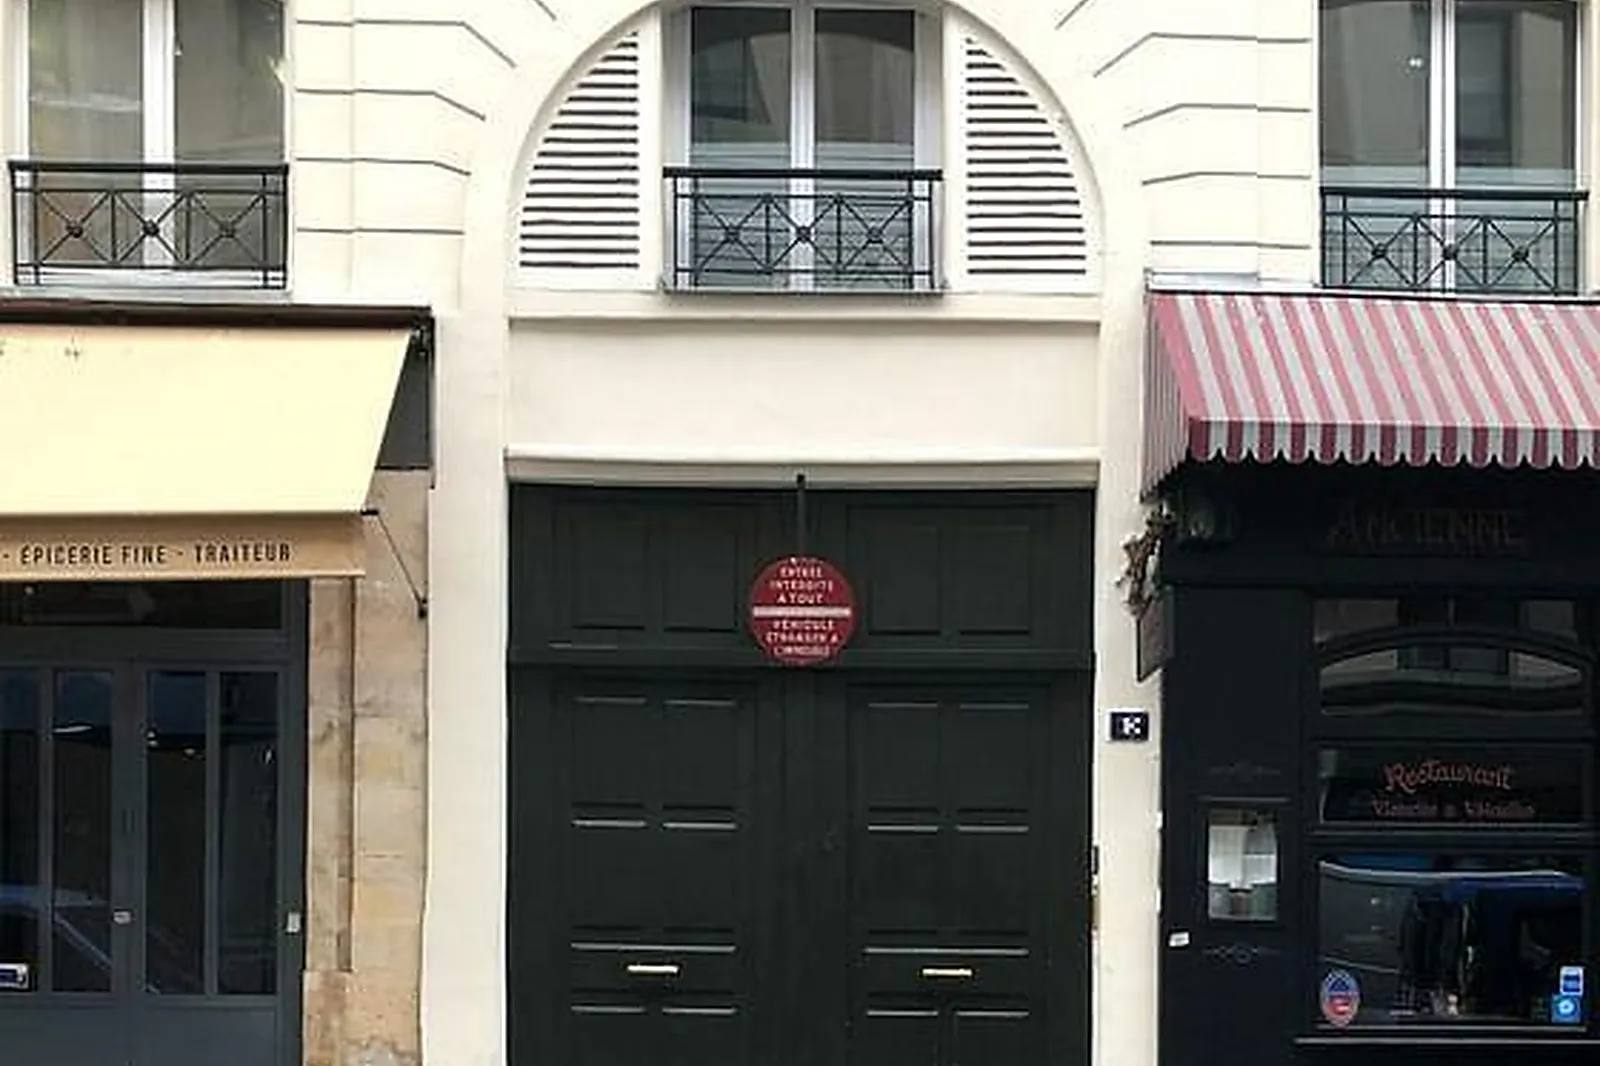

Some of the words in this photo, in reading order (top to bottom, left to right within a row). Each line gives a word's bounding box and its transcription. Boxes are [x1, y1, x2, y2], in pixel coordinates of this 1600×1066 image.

[122, 545, 167, 564] FINE
[195, 543, 291, 563] TRAITEUR
[1382, 760, 1512, 795] Restaurant
